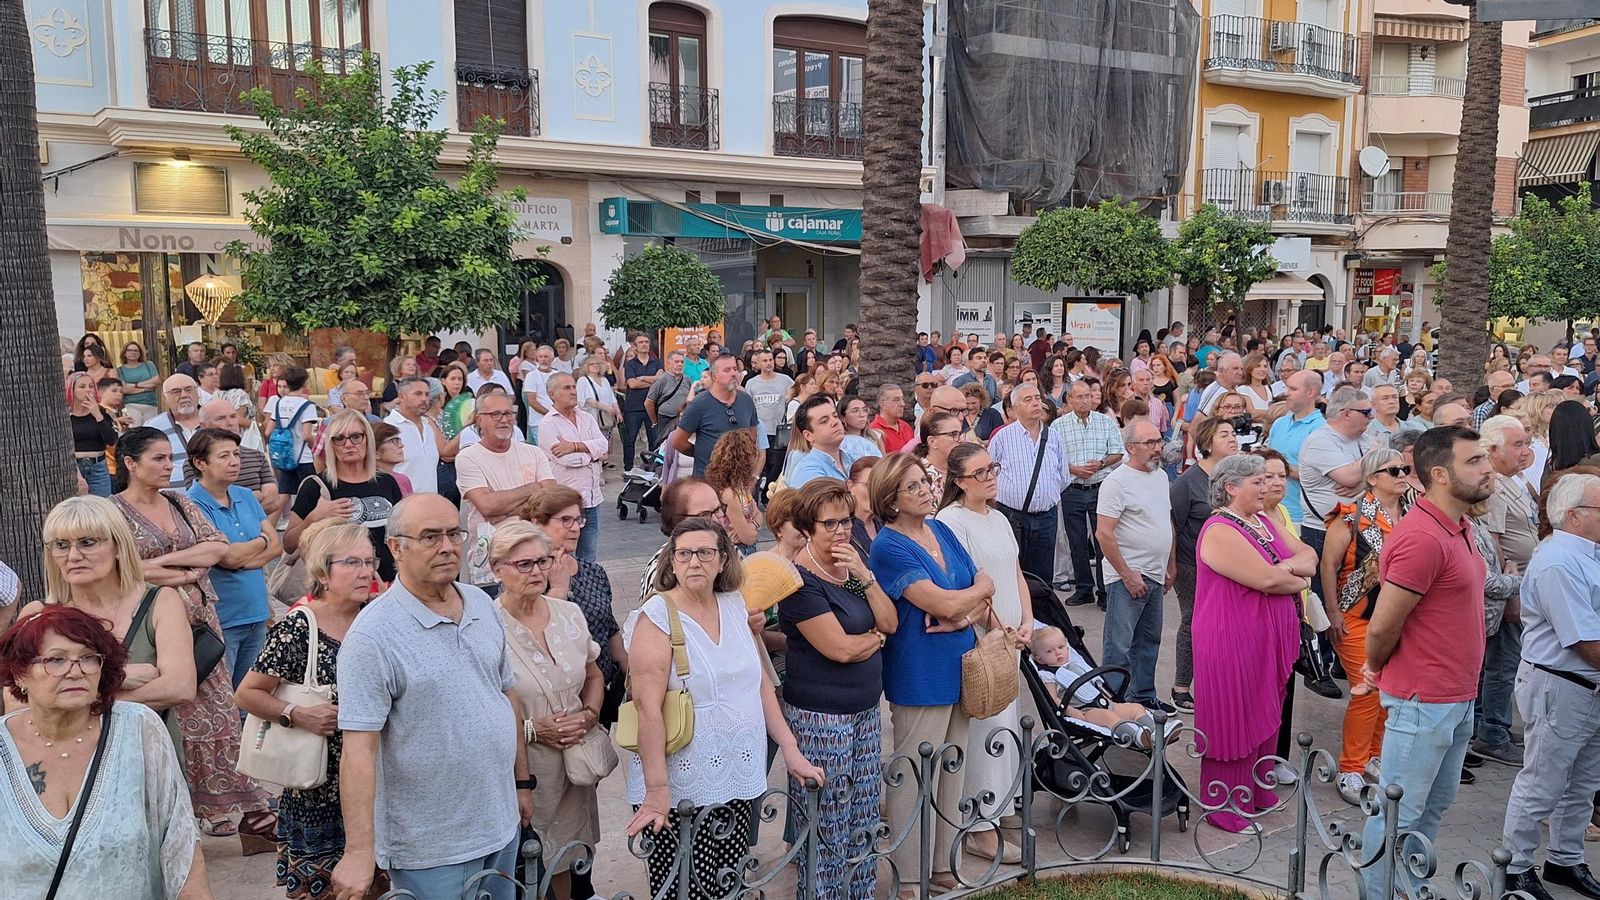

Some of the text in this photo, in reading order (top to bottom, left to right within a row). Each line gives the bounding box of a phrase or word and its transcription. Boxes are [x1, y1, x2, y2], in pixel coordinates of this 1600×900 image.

[509, 203, 558, 214] DIFICIO
[787, 214, 843, 234] cajamar
[119, 227, 195, 250] Nono
